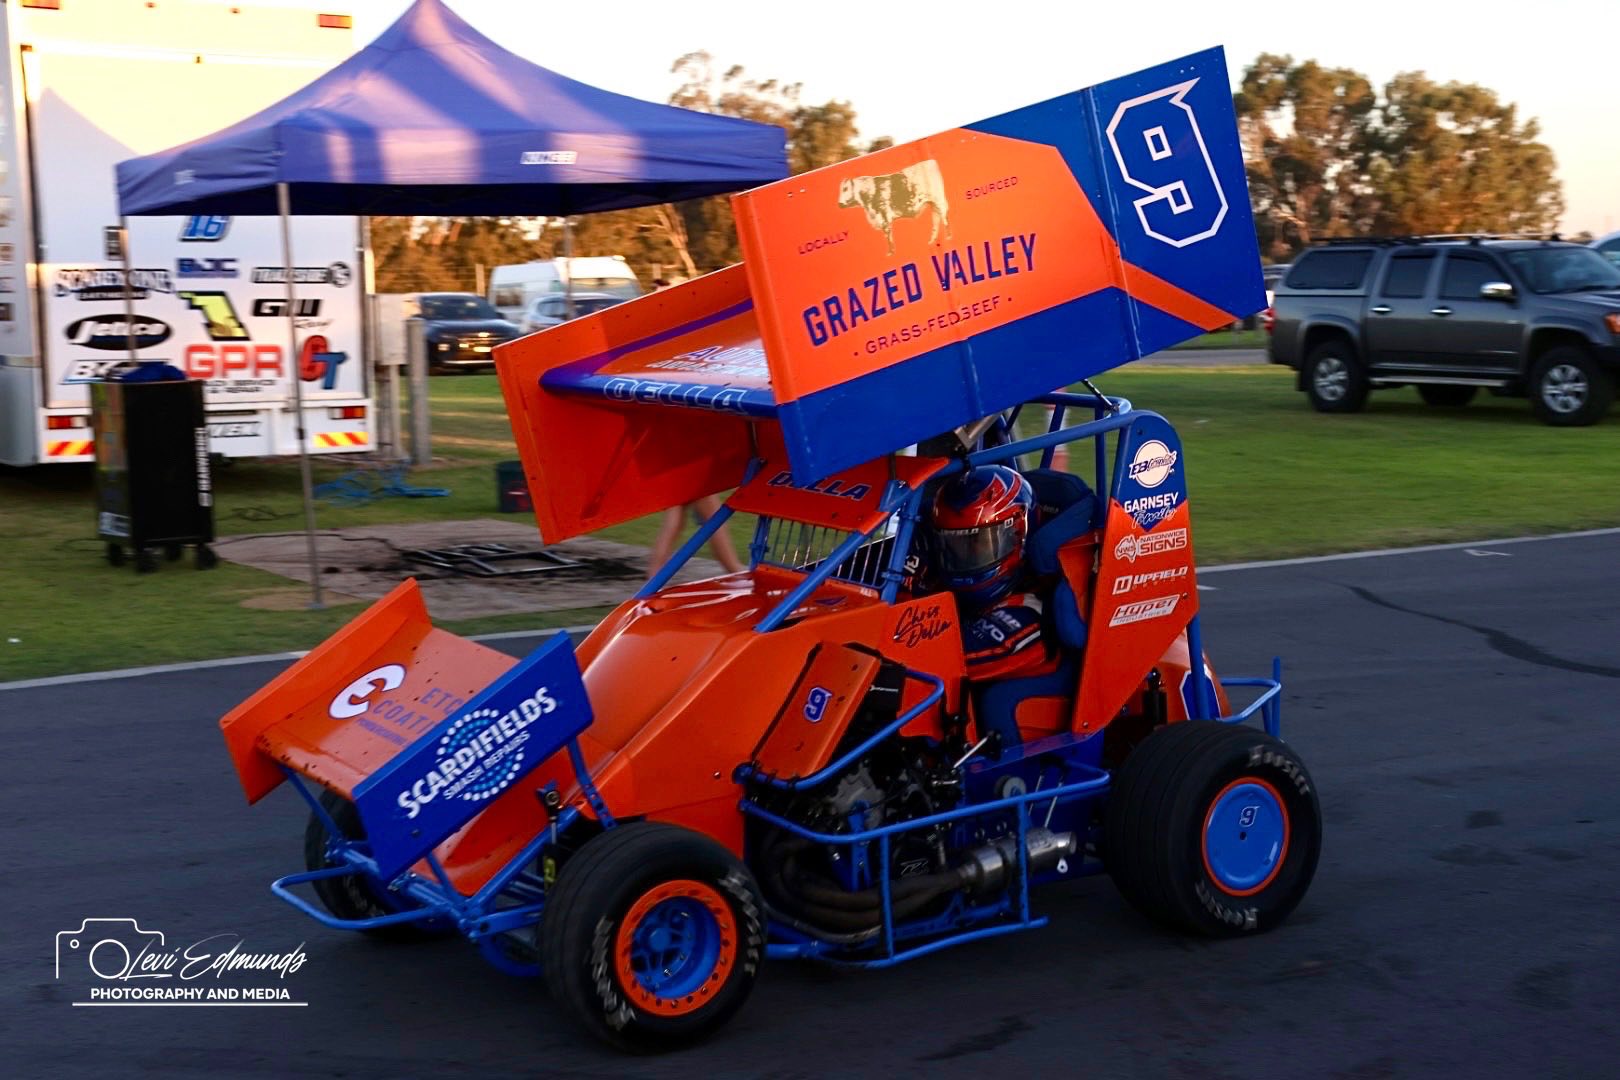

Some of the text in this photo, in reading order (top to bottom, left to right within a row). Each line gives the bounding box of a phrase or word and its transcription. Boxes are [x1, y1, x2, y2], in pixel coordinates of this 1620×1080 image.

[1105, 76, 1229, 248] 9
[964, 176, 1019, 200] SOURCED
[797, 231, 850, 256] LOCALLY
[802, 232, 1037, 347] GRAZED VALLEY
[185, 344, 283, 378] GPR
[603, 377, 748, 414] DELLA
[766, 470, 872, 501] DLLA
[1124, 492, 1179, 513] GARNSEY
[1140, 529, 1186, 544] NATIONWIDE
[1140, 536, 1186, 554] SIGNS
[1133, 566, 1189, 585] UPFIELD
[1115, 598, 1175, 618] Hyper
[803, 686, 832, 722] 9
[397, 686, 557, 819] SCARDIFIELDS
[1238, 805, 1260, 827] 9
